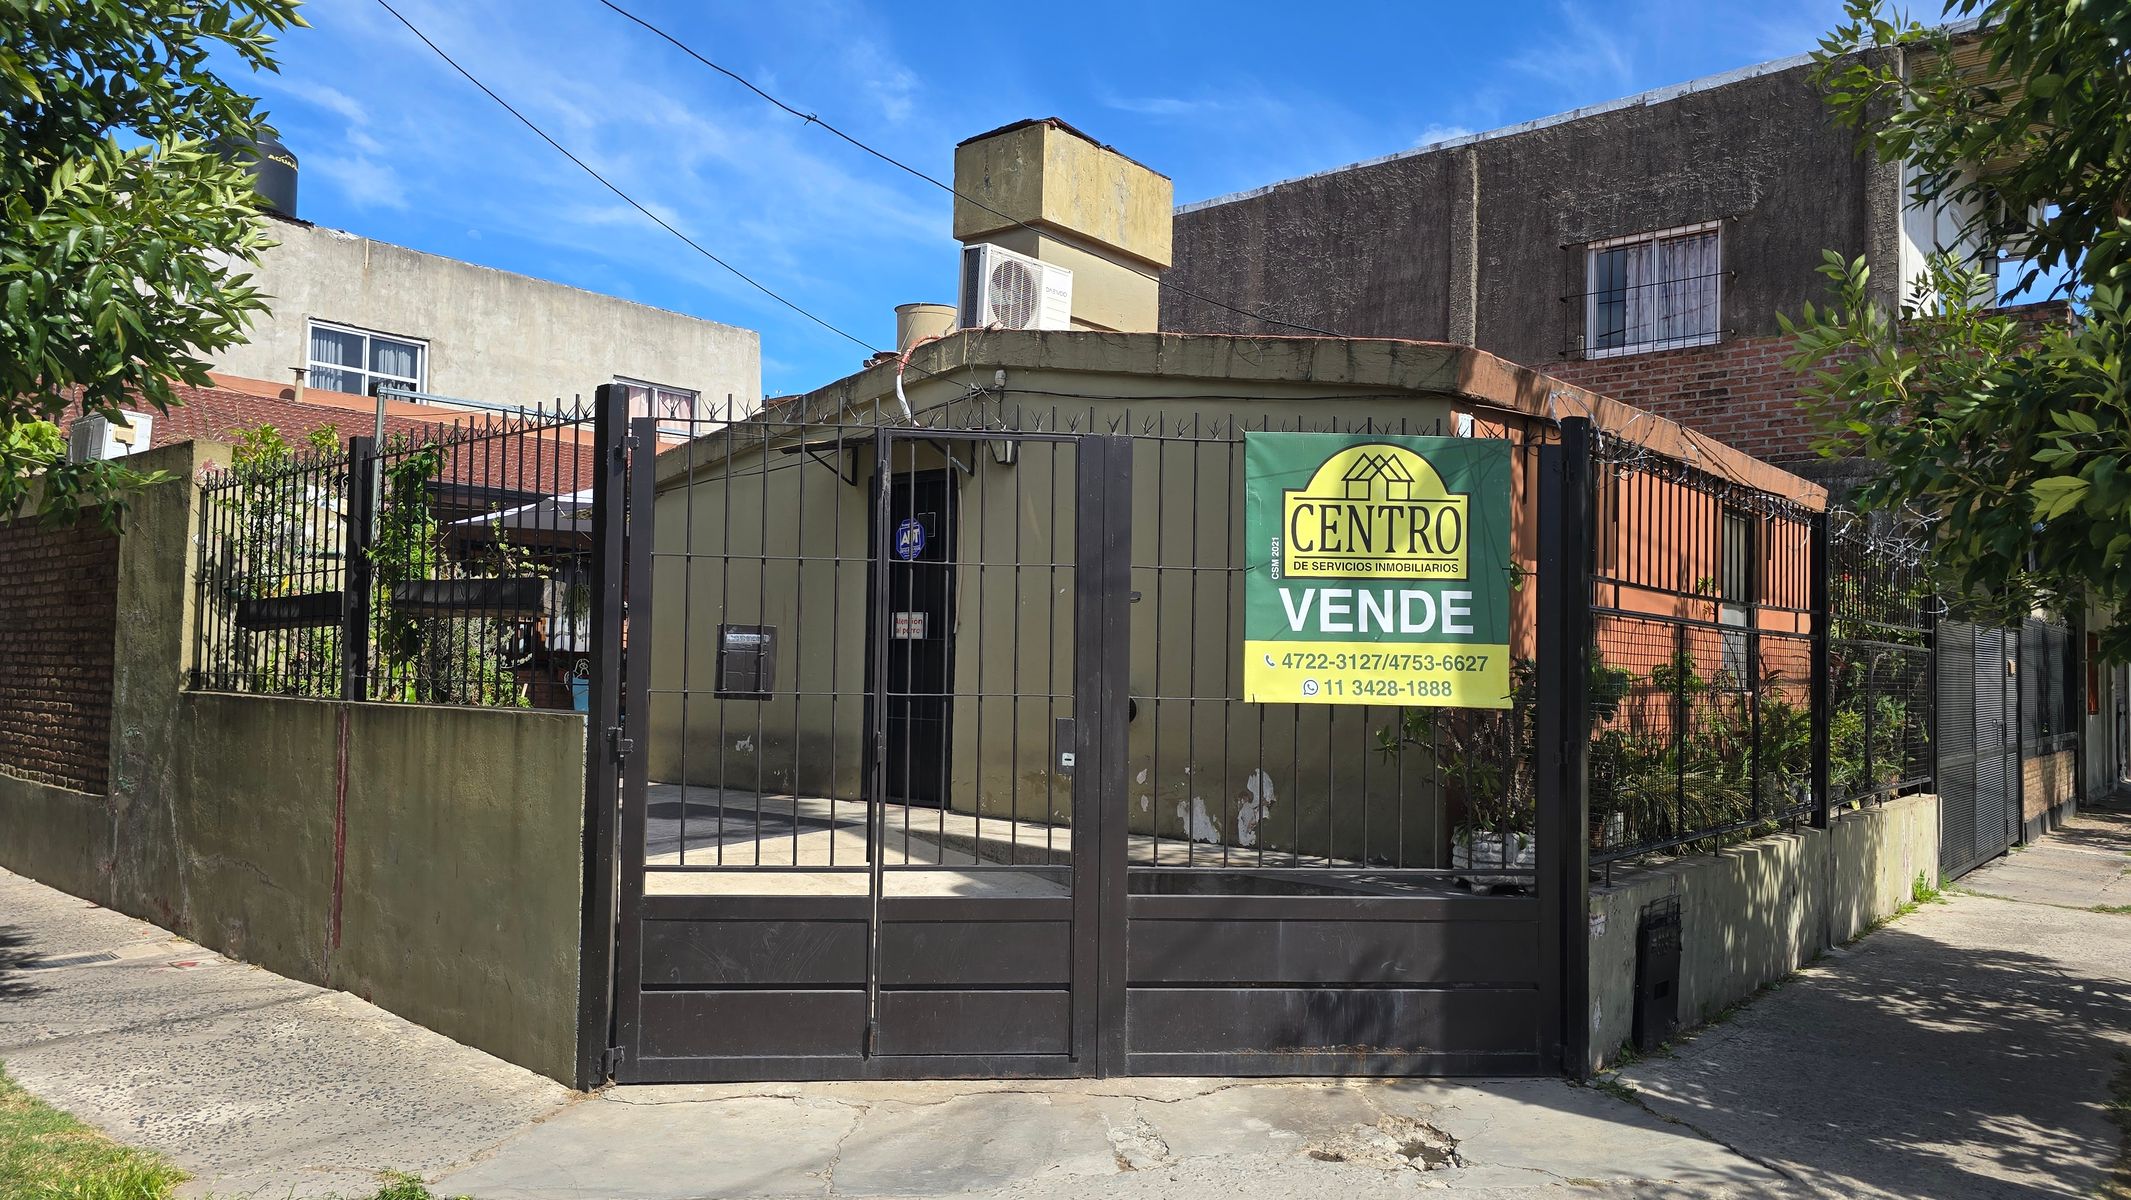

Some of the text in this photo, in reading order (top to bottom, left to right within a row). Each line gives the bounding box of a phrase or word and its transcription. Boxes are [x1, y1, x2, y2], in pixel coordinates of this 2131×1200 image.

[1291, 503, 1462, 555] CENTRO
[1271, 536, 1280, 580] CSM 2021
[1293, 561, 1459, 573] DE SERVICIOS INMOBILIARIOS
[1278, 587, 1474, 634] VENDE
[1281, 653, 1489, 672] 4722-3127/4753-6627
[1324, 679, 1452, 697] 11 3428-1888
